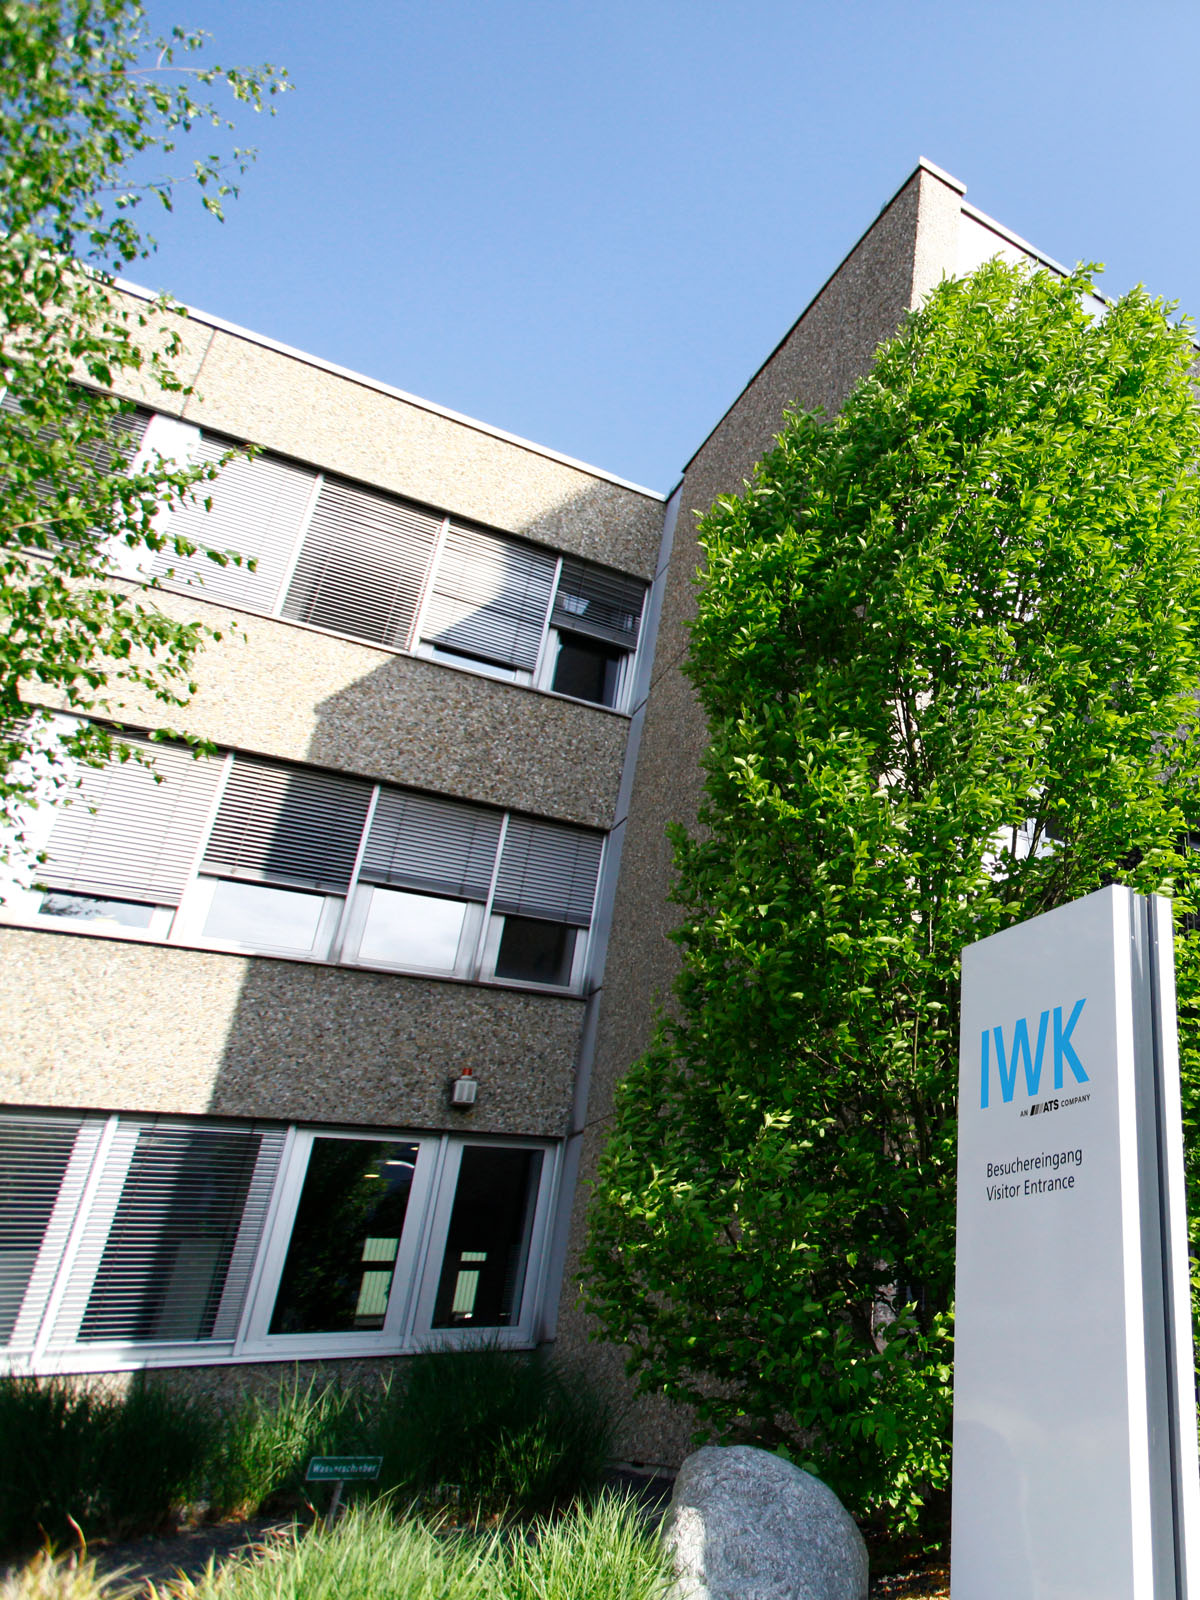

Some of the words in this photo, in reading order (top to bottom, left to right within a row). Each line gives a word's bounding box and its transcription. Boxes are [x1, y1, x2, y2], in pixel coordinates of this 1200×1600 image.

[980, 998, 1090, 1110] IWK
[1020, 1109, 1028, 1117] AN
[1060, 1093, 1091, 1108] COMPANY
[986, 1148, 1083, 1178] Besuchereingang
[986, 1183, 1021, 1201] Visitor
[1024, 1175, 1075, 1196] Entrance
